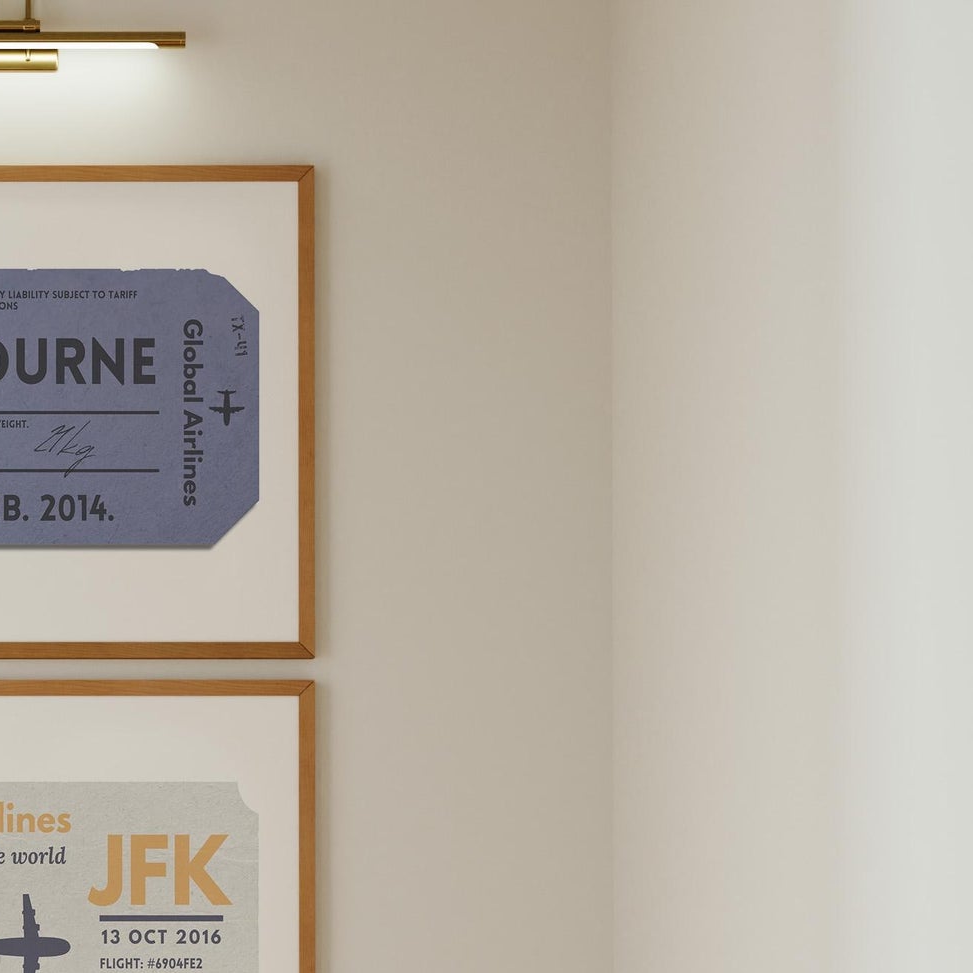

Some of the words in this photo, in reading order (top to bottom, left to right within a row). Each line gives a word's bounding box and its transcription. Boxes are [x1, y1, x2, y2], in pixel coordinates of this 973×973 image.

[8, 290, 50, 300] LIABILITY
[52, 290, 90, 300] SUBJECT
[92, 290, 106, 300] TO
[108, 290, 138, 300] TARIFF
[183, 319, 204, 403] Global
[183, 409, 204, 507] Airlines
[39, 494, 115, 522] 2014.
[12, 846, 67, 865] world
[87, 834, 233, 906] JFK
[101, 929, 121, 944] 13
[128, 929, 167, 944] OCT
[175, 929, 221, 944] 2016
[99, 958, 143, 969] FLIGHT:
[147, 958, 203, 969] #6904FE2
